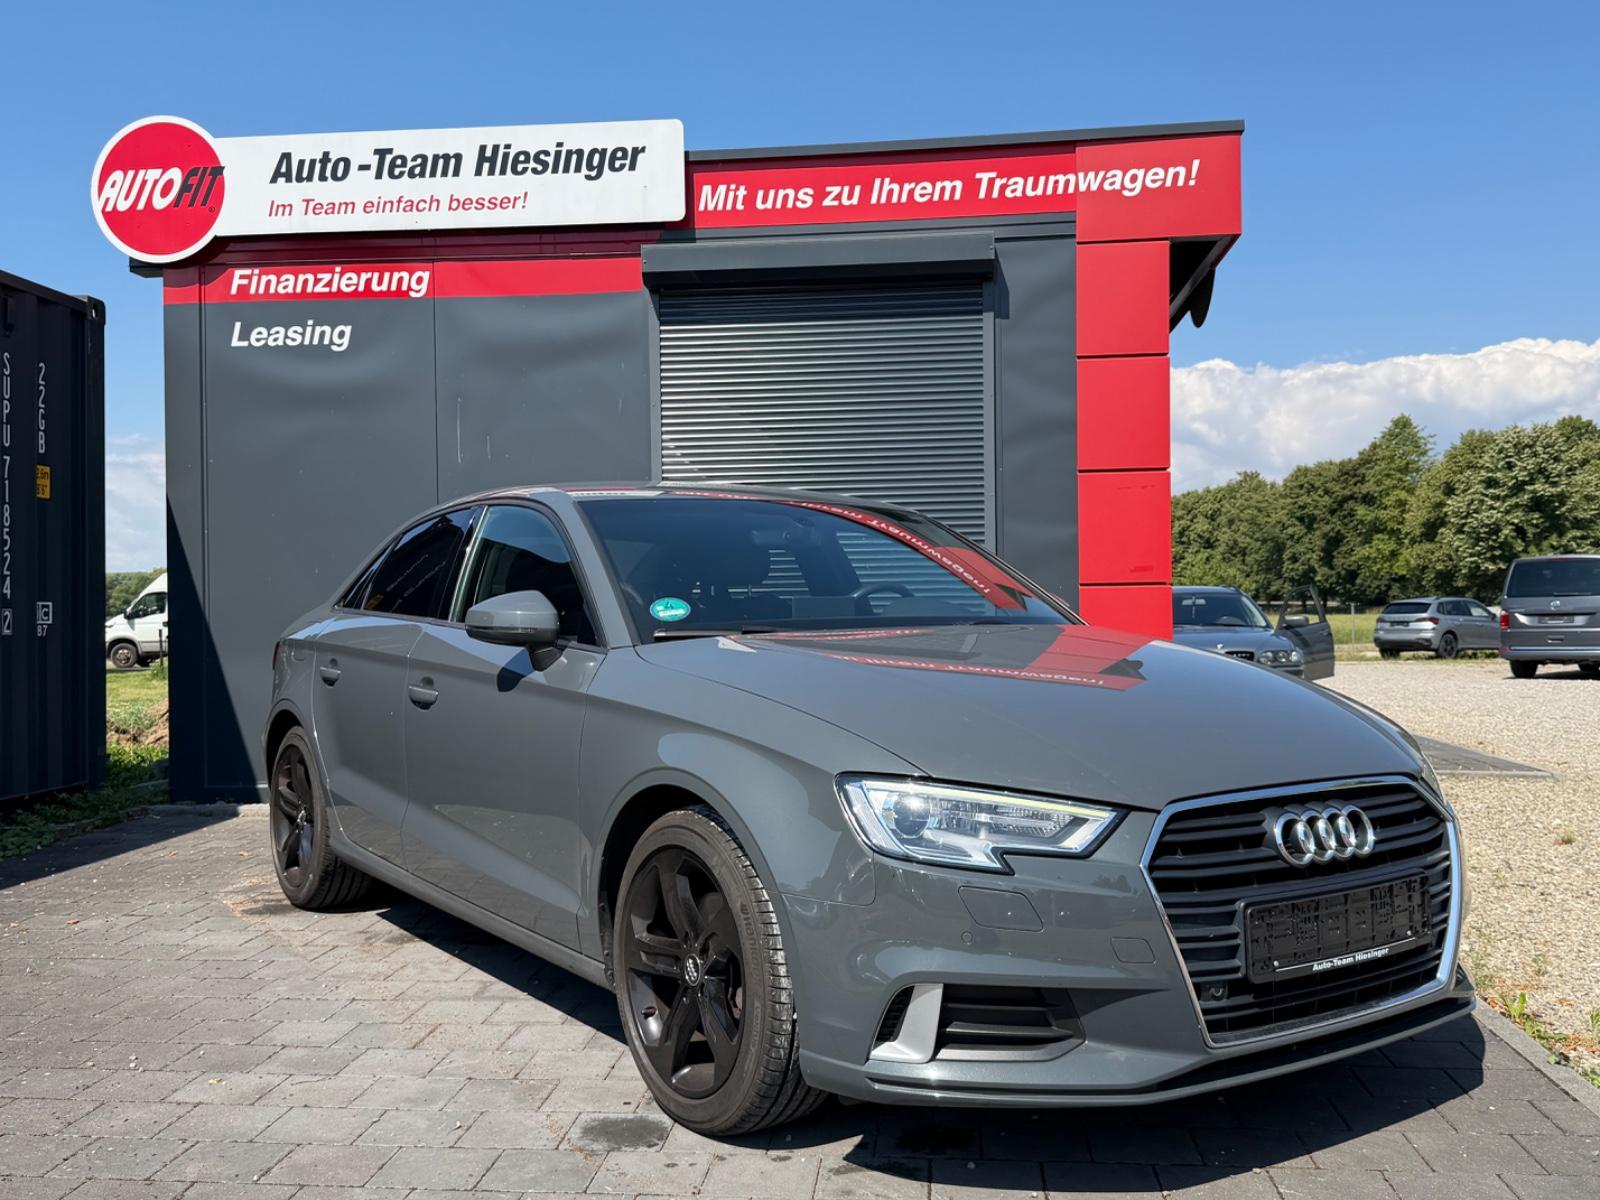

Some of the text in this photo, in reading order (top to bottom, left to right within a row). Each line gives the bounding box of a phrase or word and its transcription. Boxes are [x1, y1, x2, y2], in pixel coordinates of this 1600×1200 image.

[474, 142, 647, 182] Hiesinger
[98, 165, 226, 212] AUTOFIT
[699, 158, 1201, 212] Mit uns zu Ihrem Traumwagen!
[268, 192, 529, 217] Im Team einfach besser!
[231, 266, 431, 298] Finanzierung
[231, 319, 353, 352] Leasing
[3, 352, 11, 633] SUPU 718524 2
[1312, 948, 1389, 971] Auto-Team Hiesinger
